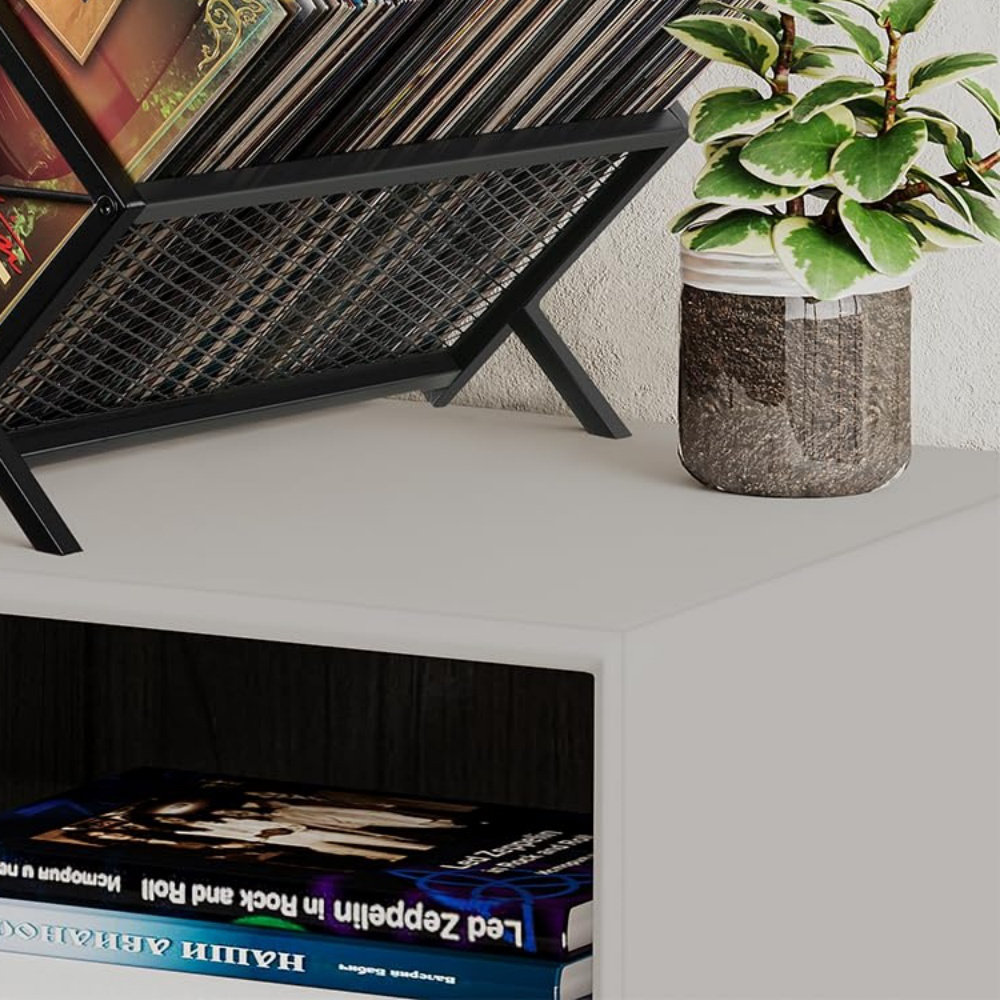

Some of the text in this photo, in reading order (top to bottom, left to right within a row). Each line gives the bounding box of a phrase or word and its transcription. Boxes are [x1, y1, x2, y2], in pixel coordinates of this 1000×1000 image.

[142, 877, 523, 948] Led Zeppelin in Rock and Roll
[181, 940, 307, 973] НАШИ
